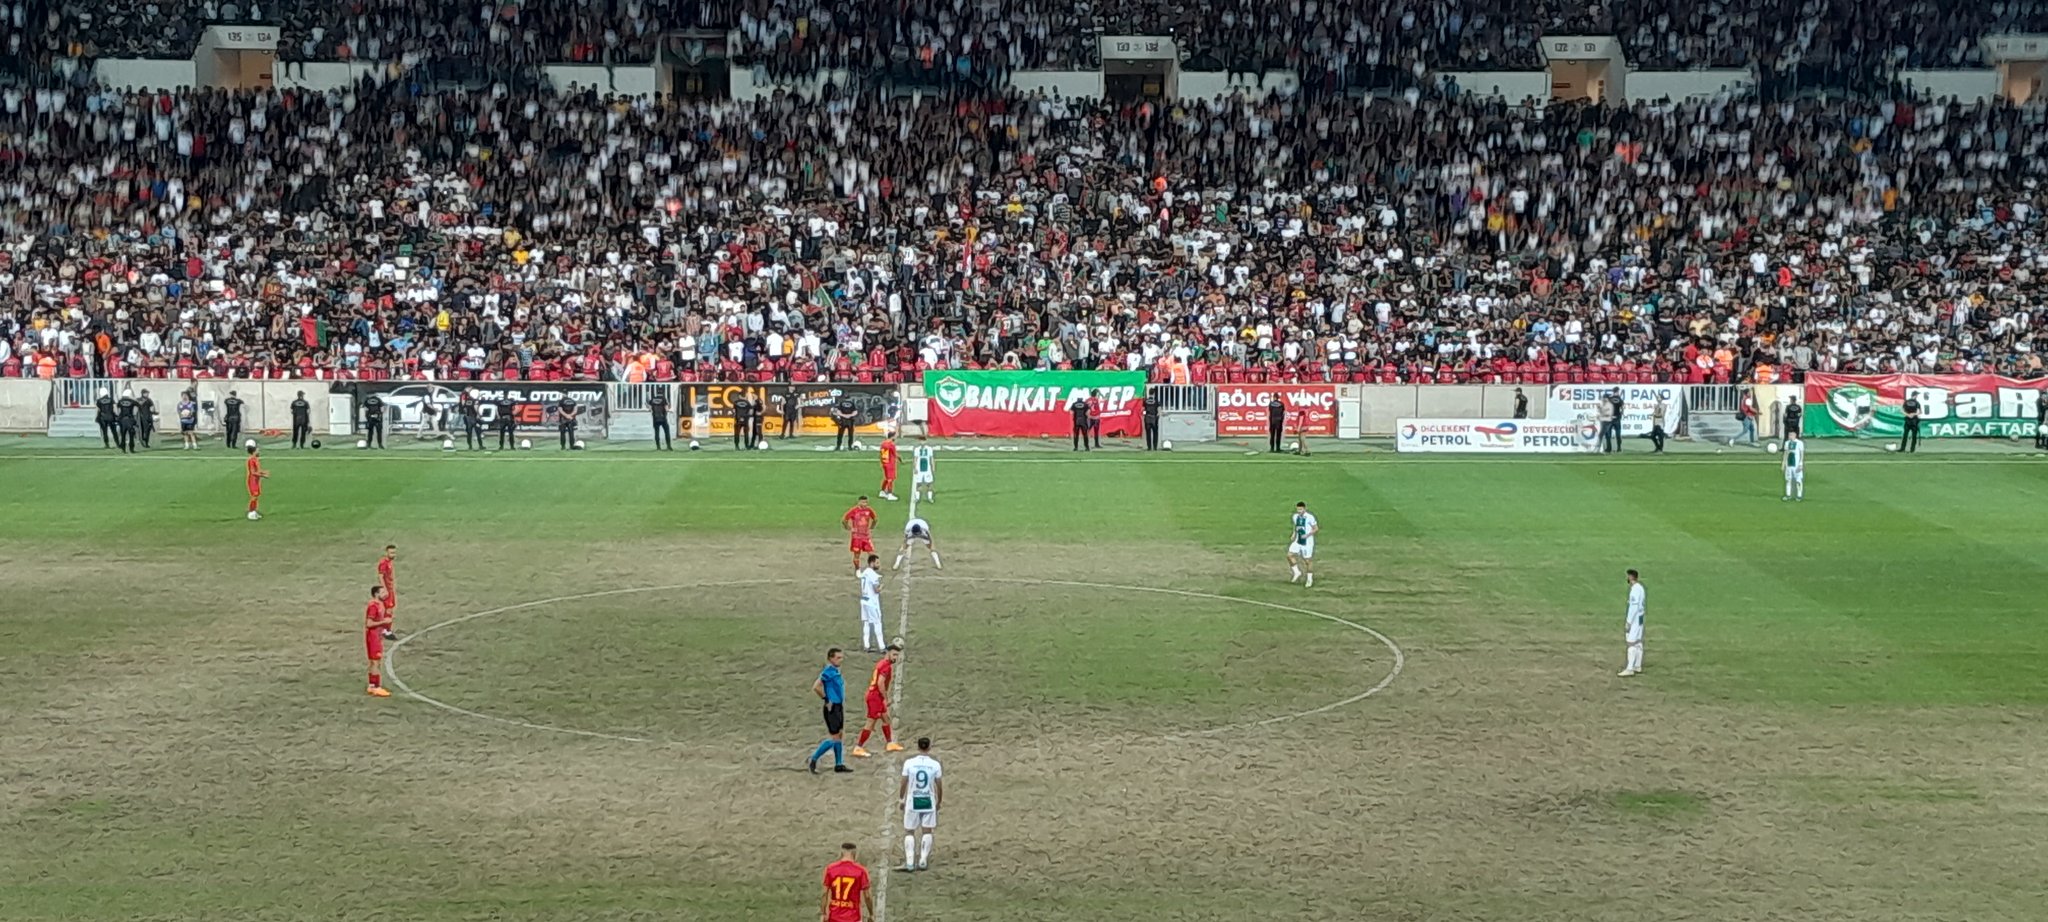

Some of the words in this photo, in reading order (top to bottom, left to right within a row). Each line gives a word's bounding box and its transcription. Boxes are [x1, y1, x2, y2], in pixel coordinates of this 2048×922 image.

[1218, 388, 1282, 407] BÖLG
[1928, 422, 2038, 436] TARAFTAR
[1421, 435, 1472, 445] PETROL
[1523, 435, 1579, 446] PETROL
[916, 770, 928, 789] 9
[832, 876, 855, 900] 17
